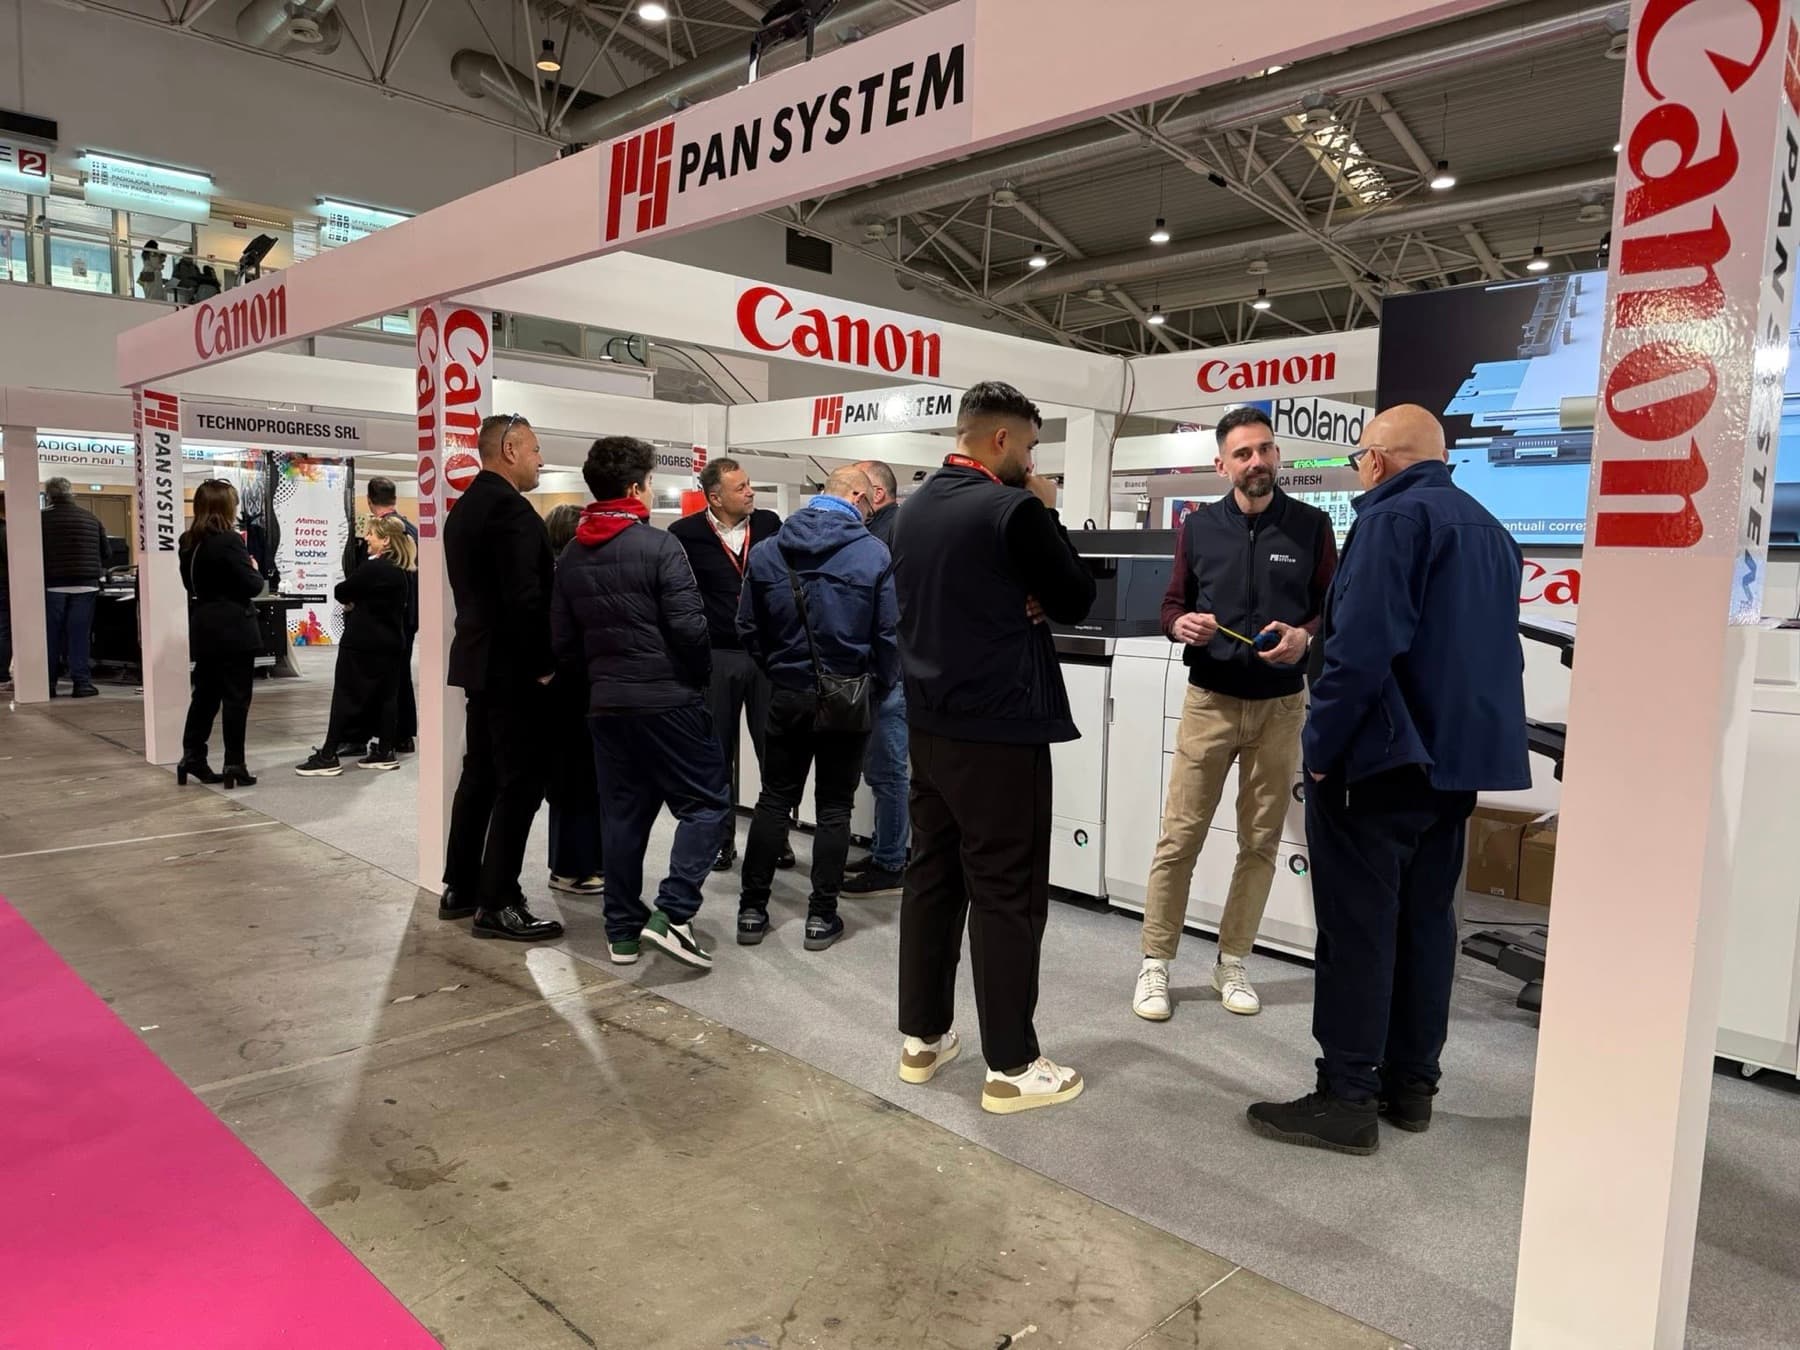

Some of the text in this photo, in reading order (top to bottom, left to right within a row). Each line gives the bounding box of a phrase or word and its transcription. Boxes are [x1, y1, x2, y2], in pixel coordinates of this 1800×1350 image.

[678, 44, 964, 193] PAN SYSTEM
[23, 153, 42, 175] 2
[1595, 0, 1781, 548] Canon
[195, 284, 287, 360] Canon
[737, 286, 941, 378] Canon
[1197, 352, 1336, 393] Canon
[197, 414, 360, 440] TECHNOPROGRESS SRL
[417, 307, 438, 538] Canon
[444, 309, 489, 512] Cano
[844, 401, 879, 424] PAN
[1275, 397, 1365, 446] Roland
[154, 432, 175, 551] PAN SYSTEM
[1292, 475, 1322, 486] FRESH
[295, 527, 328, 536] trotec
[295, 539, 327, 547] xerox
[295, 549, 328, 558] brother
